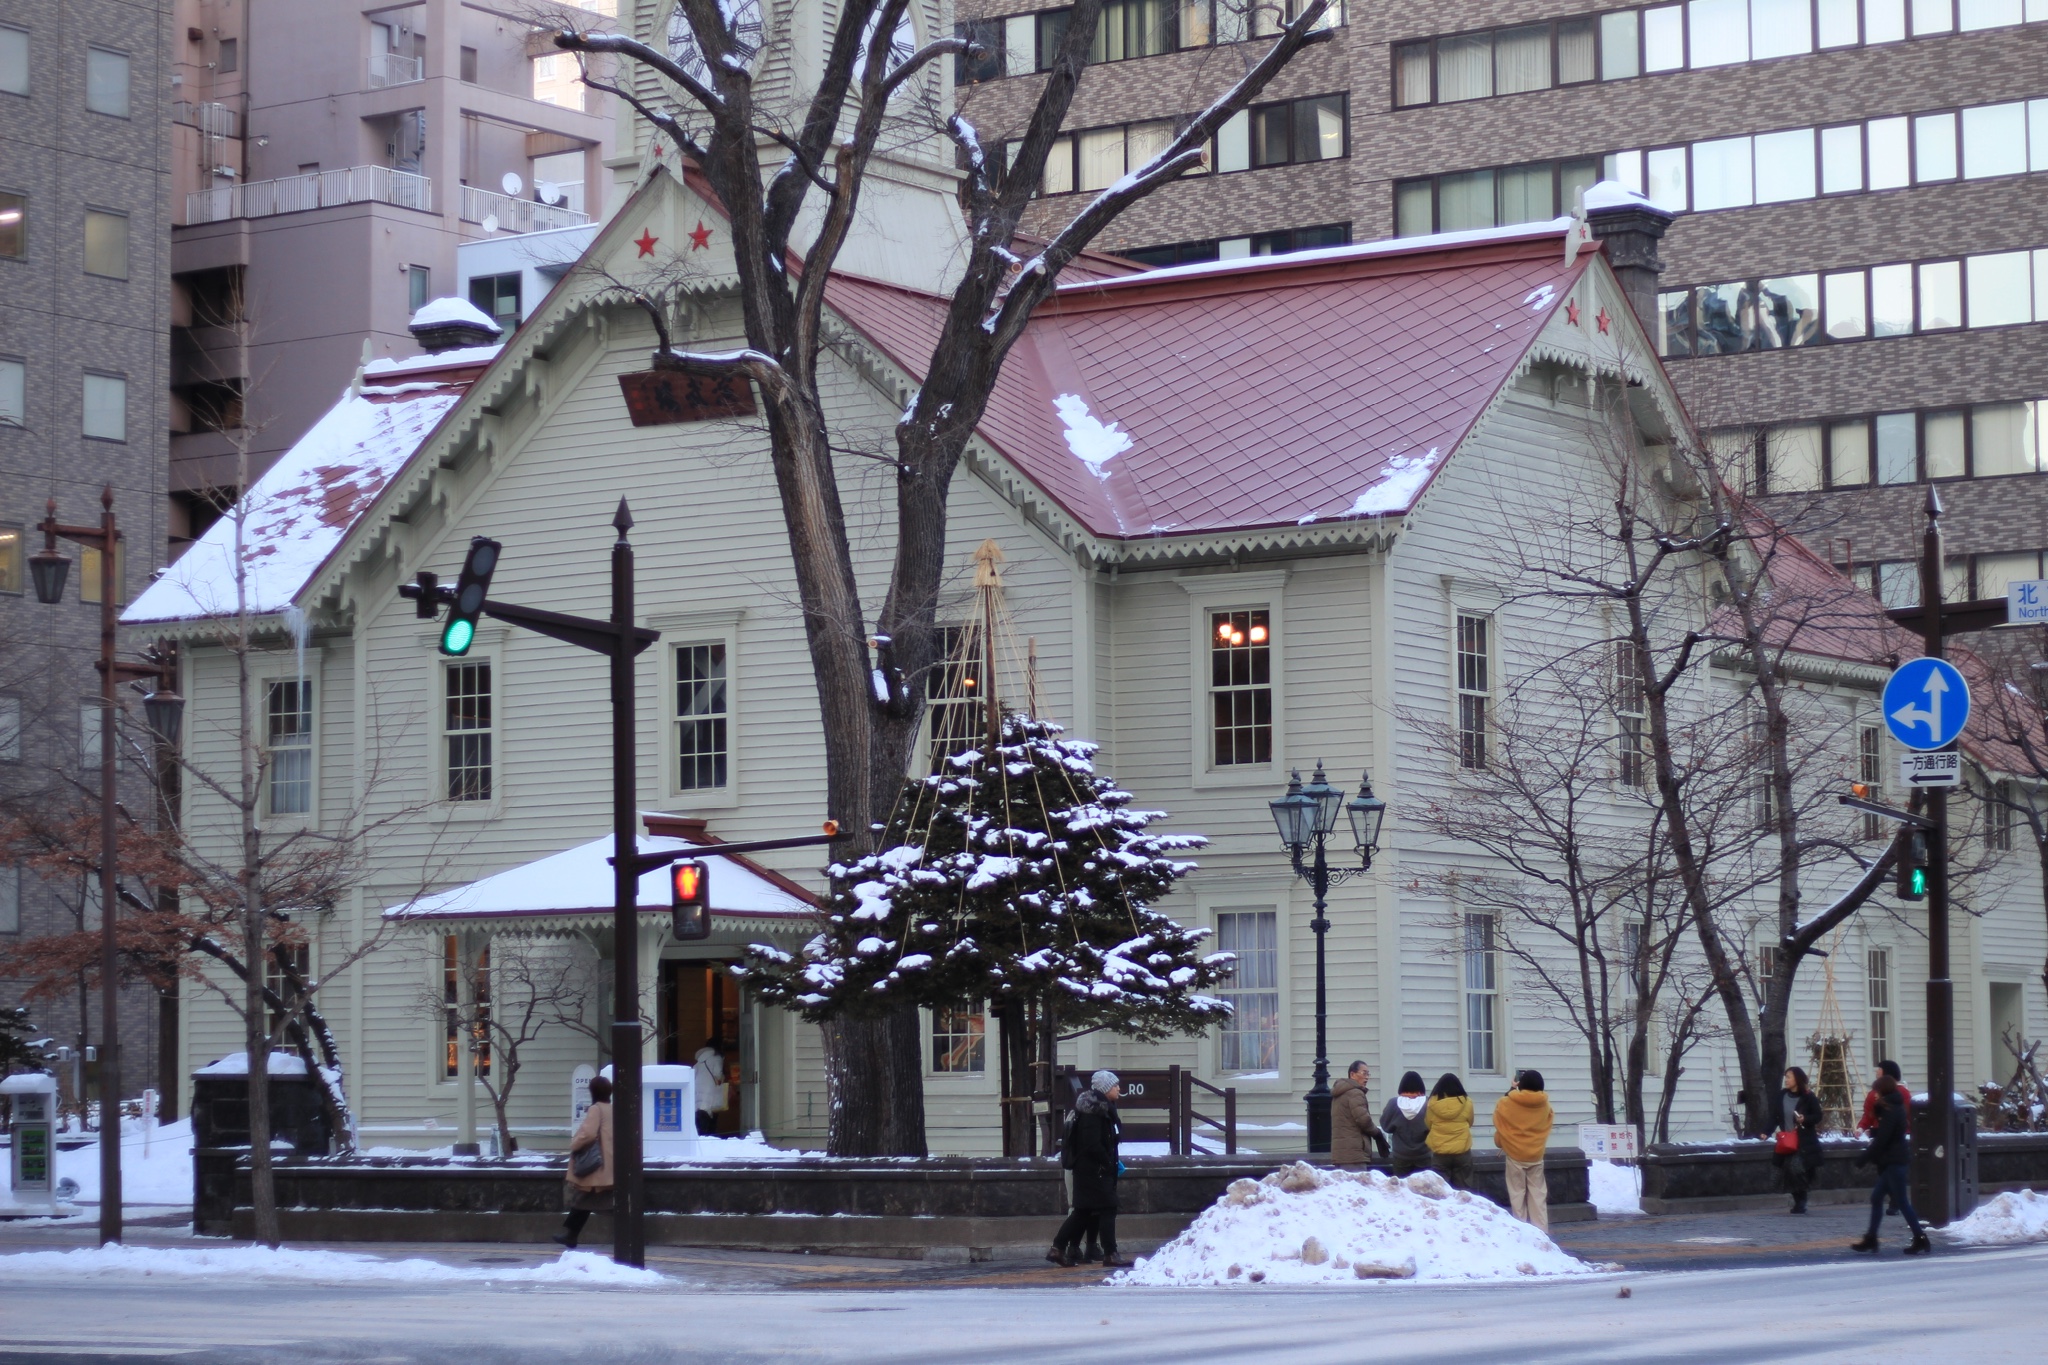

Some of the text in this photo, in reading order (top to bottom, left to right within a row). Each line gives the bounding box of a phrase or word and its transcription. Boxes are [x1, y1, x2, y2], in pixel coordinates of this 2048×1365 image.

[2018, 584, 2038, 605] 北
[2018, 606, 2048, 618] North
[1903, 755, 1957, 770] 一方通行路
